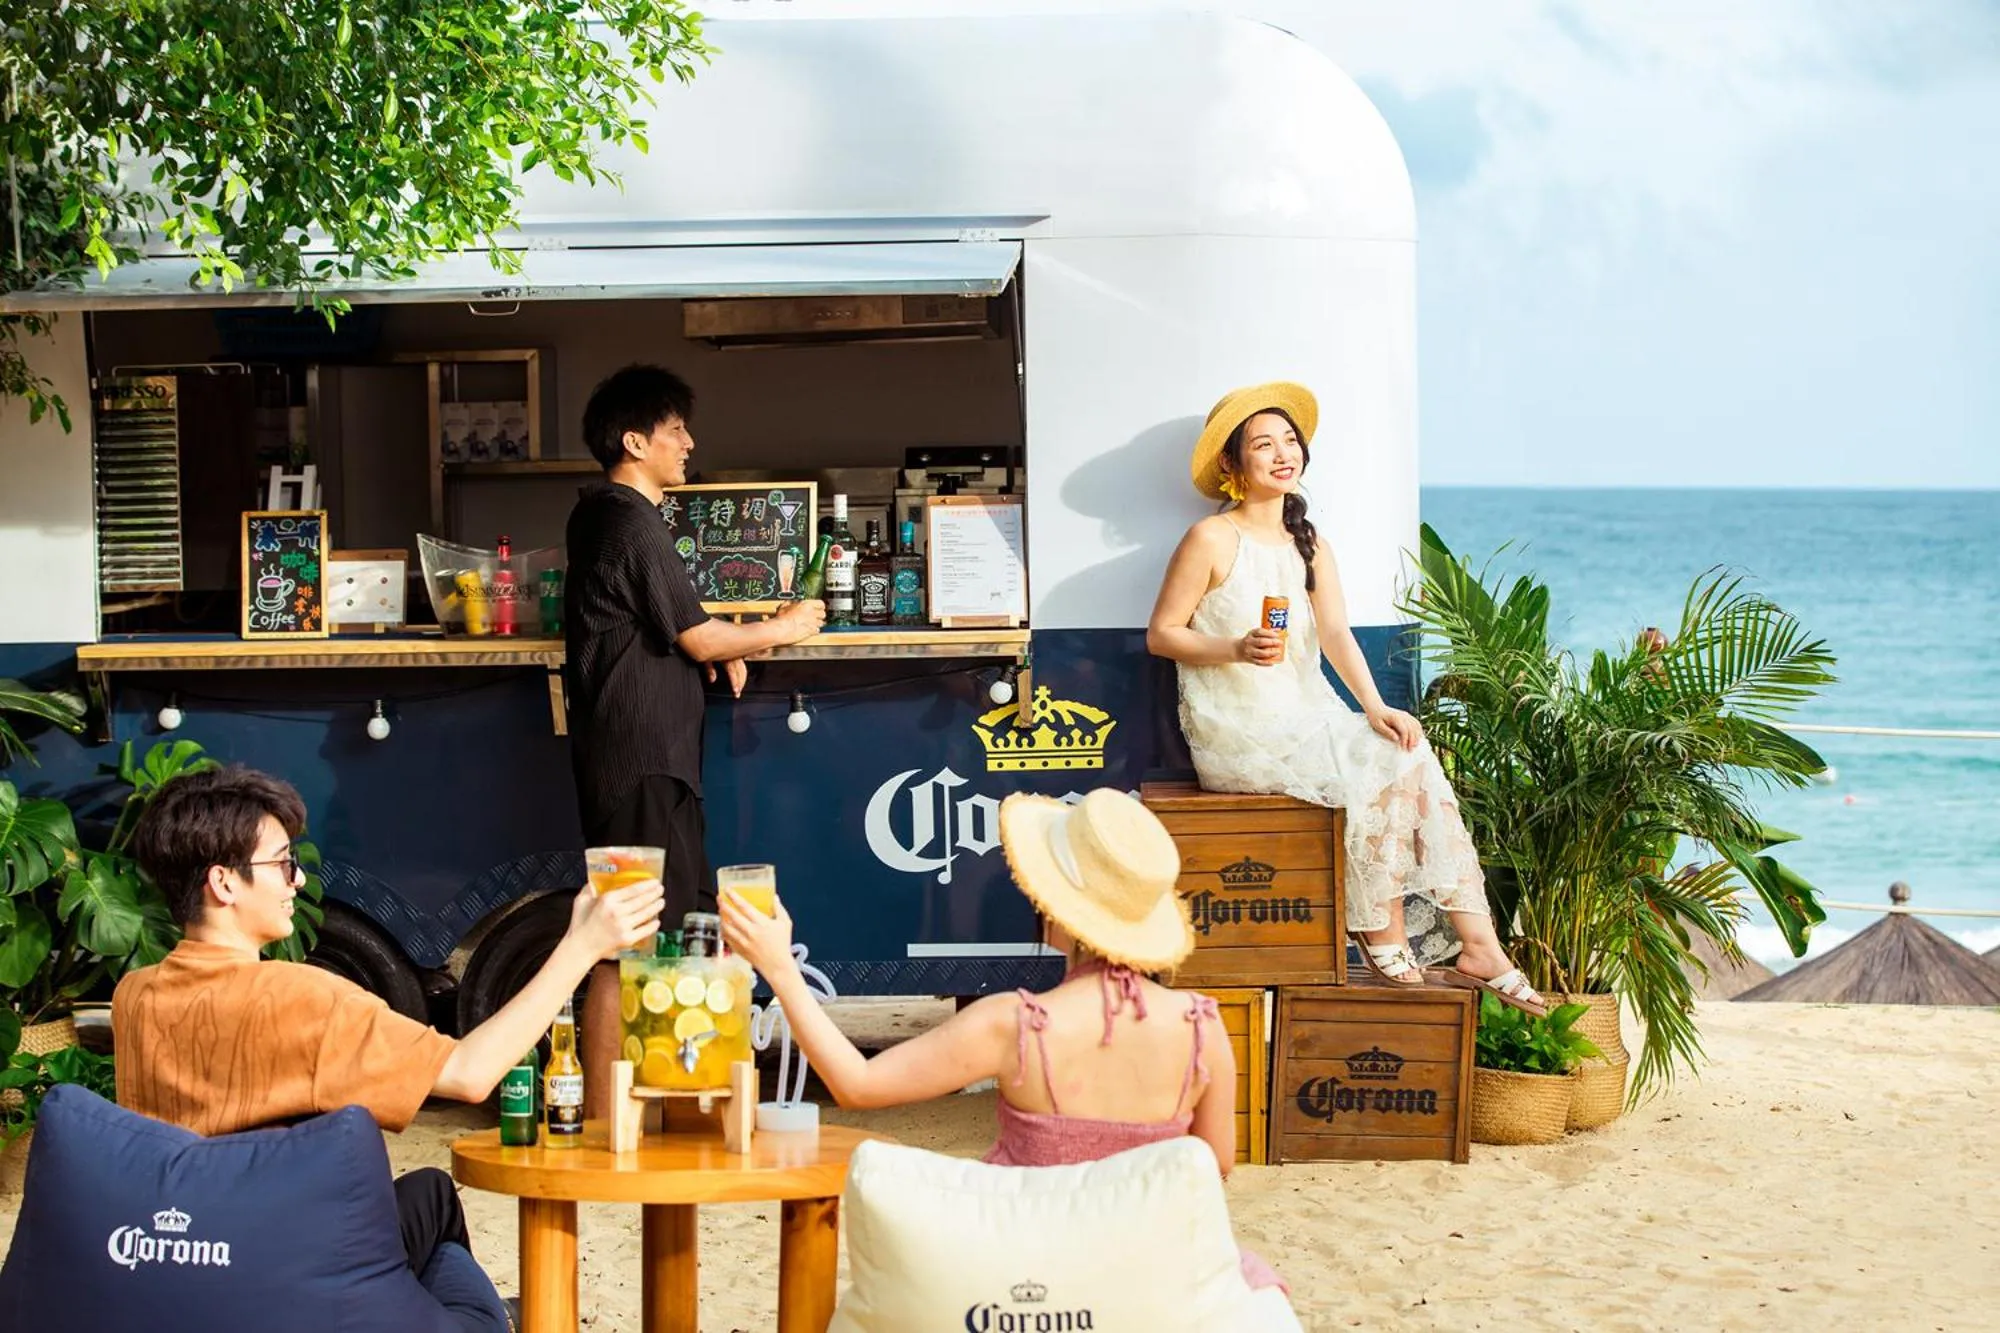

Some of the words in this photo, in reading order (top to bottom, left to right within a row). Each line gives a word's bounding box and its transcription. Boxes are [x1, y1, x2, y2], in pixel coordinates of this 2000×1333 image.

[249, 611, 296, 630] Coffee
[1296, 1076, 1439, 1124] Corona
[107, 1225, 231, 1271] Corona
[965, 1302, 1093, 1333] Corona
